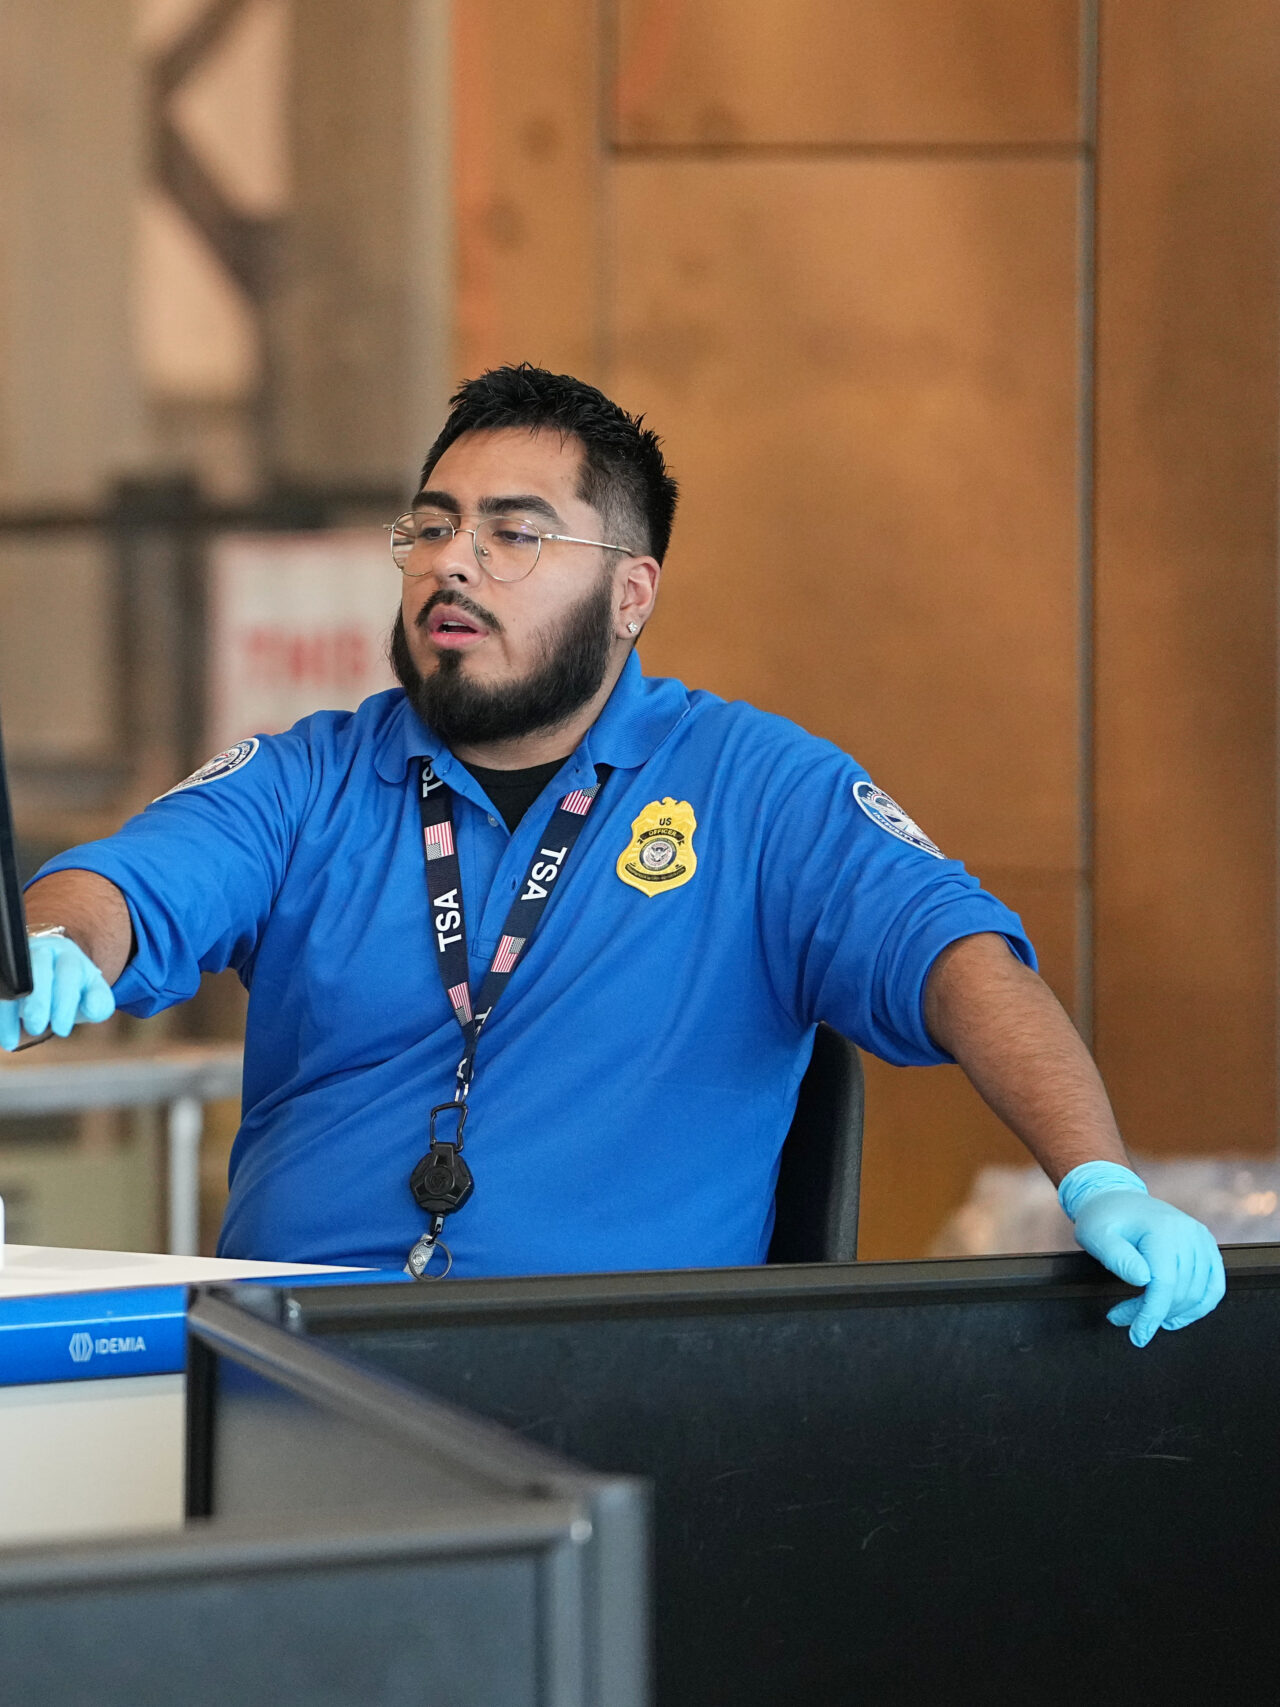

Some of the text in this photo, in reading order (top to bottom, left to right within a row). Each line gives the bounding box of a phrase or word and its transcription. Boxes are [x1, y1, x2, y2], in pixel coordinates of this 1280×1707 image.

[422, 757, 444, 798] TS
[648, 828, 677, 837] OFFICER
[659, 817, 673, 826] US
[520, 846, 568, 900] TSA
[433, 888, 462, 953] TSA
[95, 1336, 146, 1354] IDEMIA
